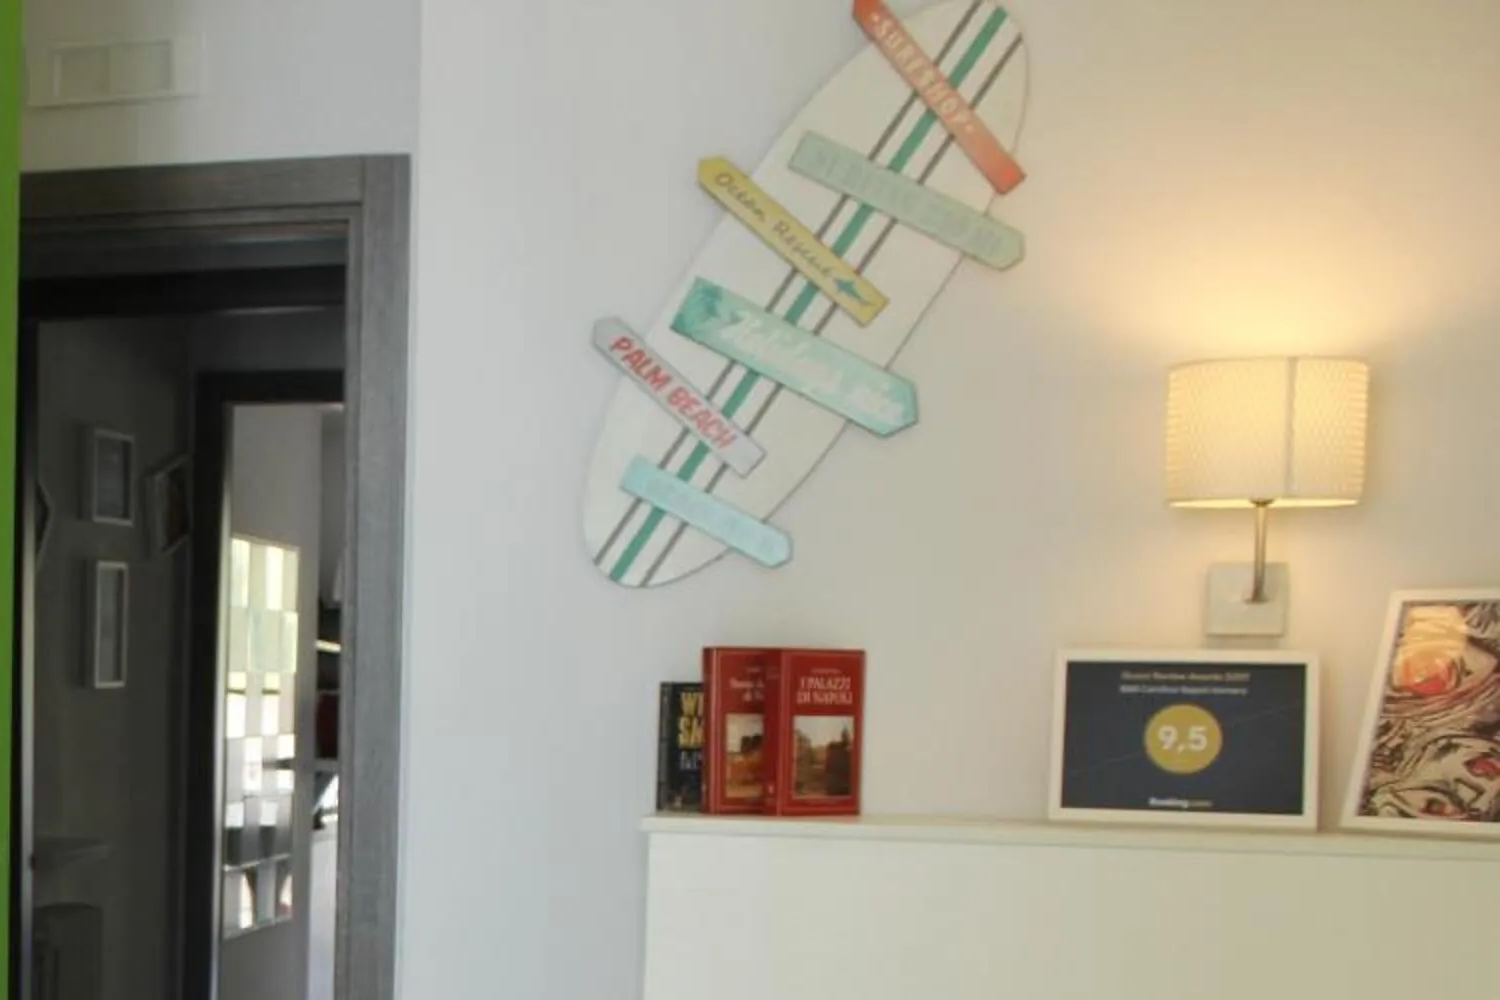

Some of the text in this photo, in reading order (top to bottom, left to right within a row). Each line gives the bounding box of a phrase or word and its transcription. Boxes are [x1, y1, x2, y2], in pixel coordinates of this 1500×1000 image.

[714, 172, 766, 223] Ocean
[608, 335, 673, 394] PALM
[667, 385, 739, 449] BEACH
